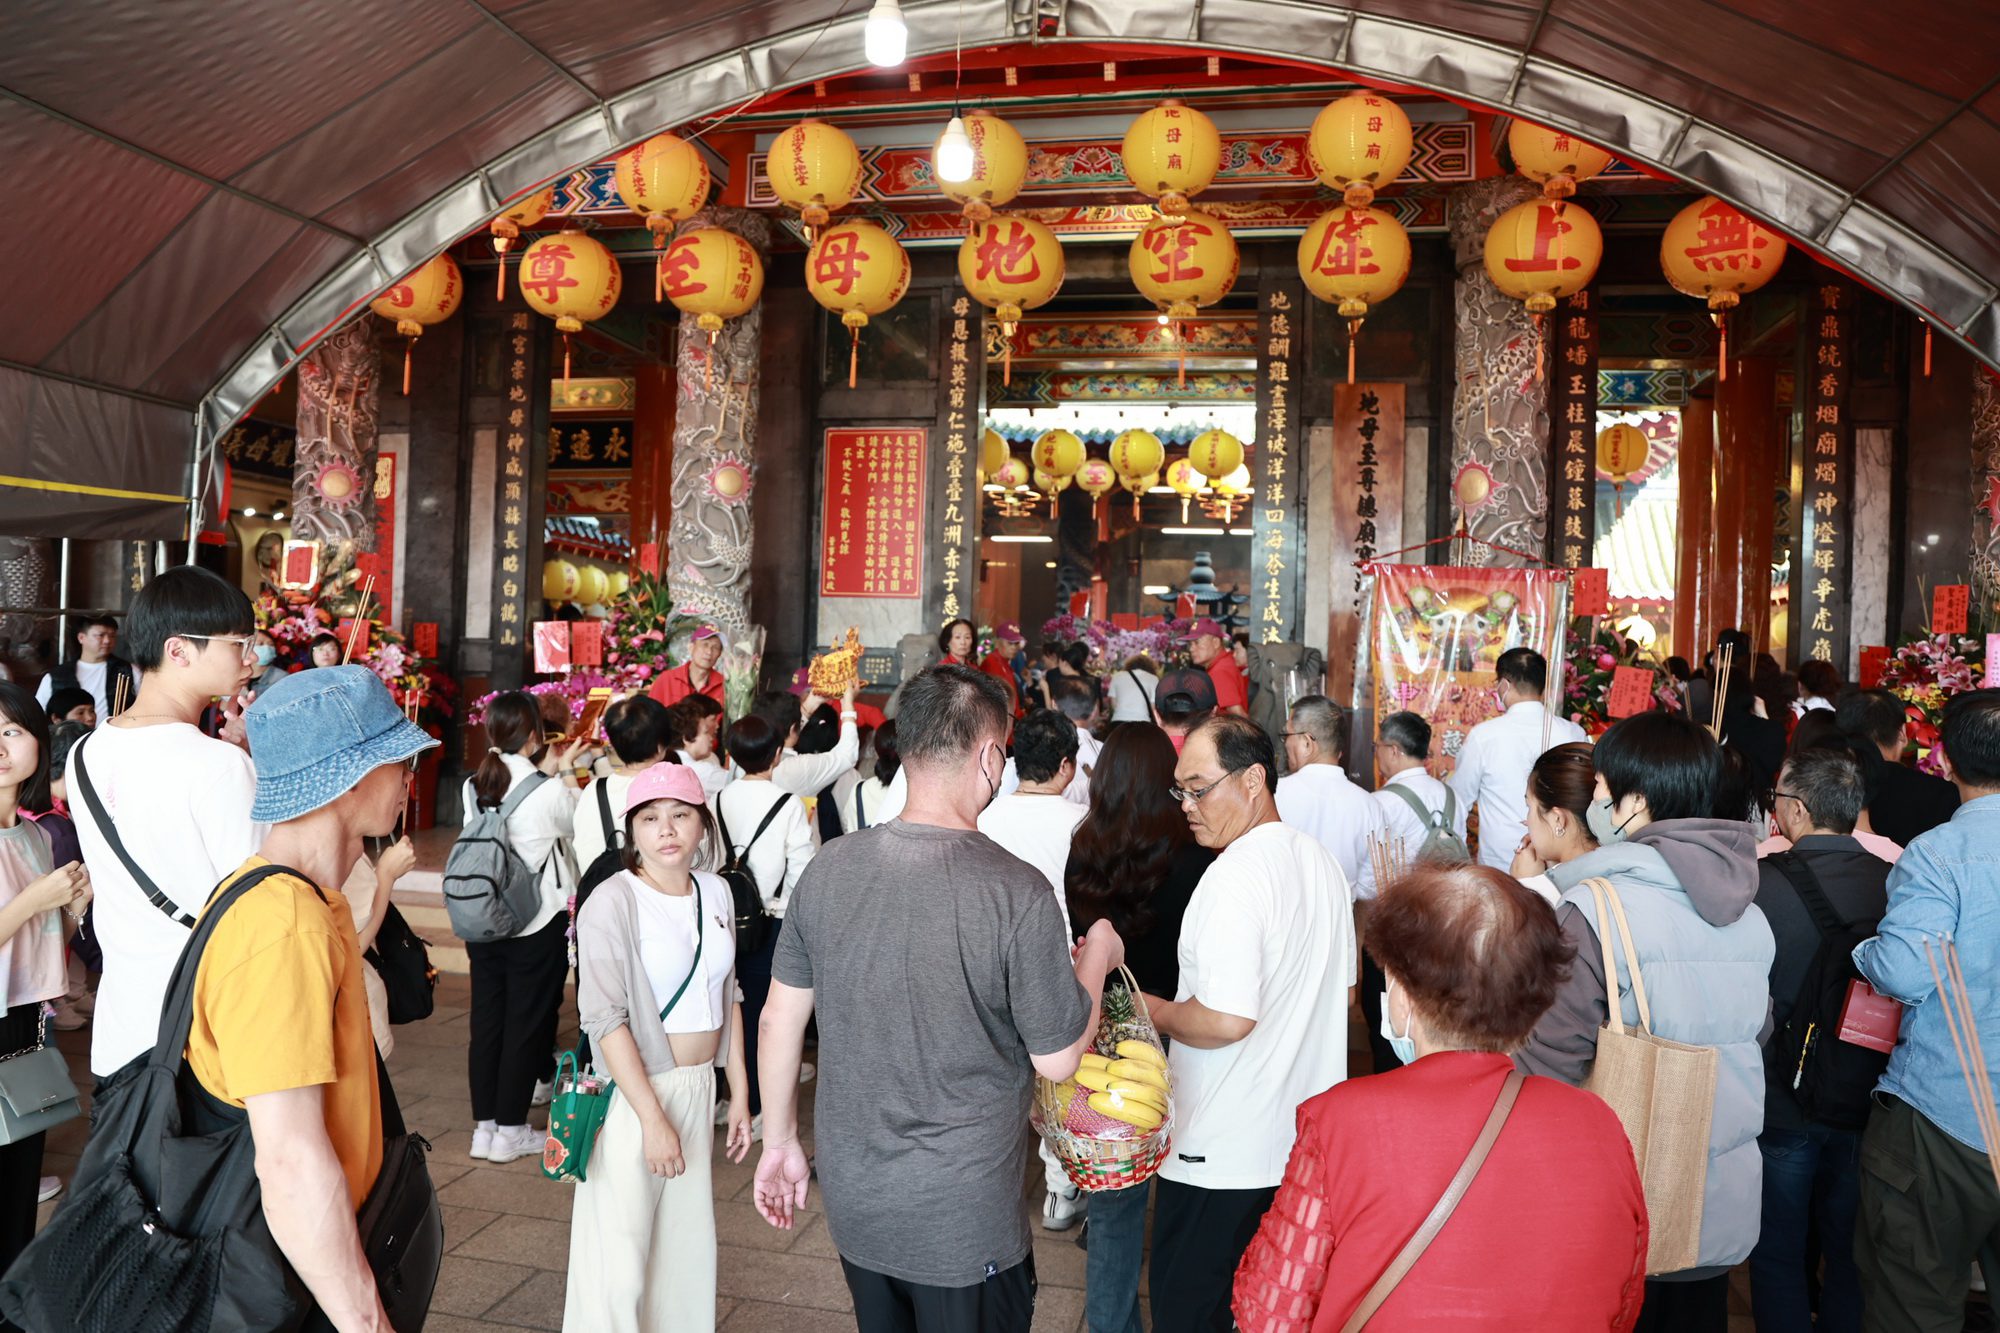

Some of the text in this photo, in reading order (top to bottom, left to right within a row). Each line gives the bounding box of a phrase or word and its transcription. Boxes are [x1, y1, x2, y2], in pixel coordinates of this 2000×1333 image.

[1165, 109, 1183, 170] 地母廟
[661, 236, 708, 298] 至
[815, 231, 870, 295] 母
[976, 221, 1041, 284] 地
[1143, 220, 1213, 283] 空
[1505, 205, 1581, 272] 上
[523, 244, 579, 304] 尊
